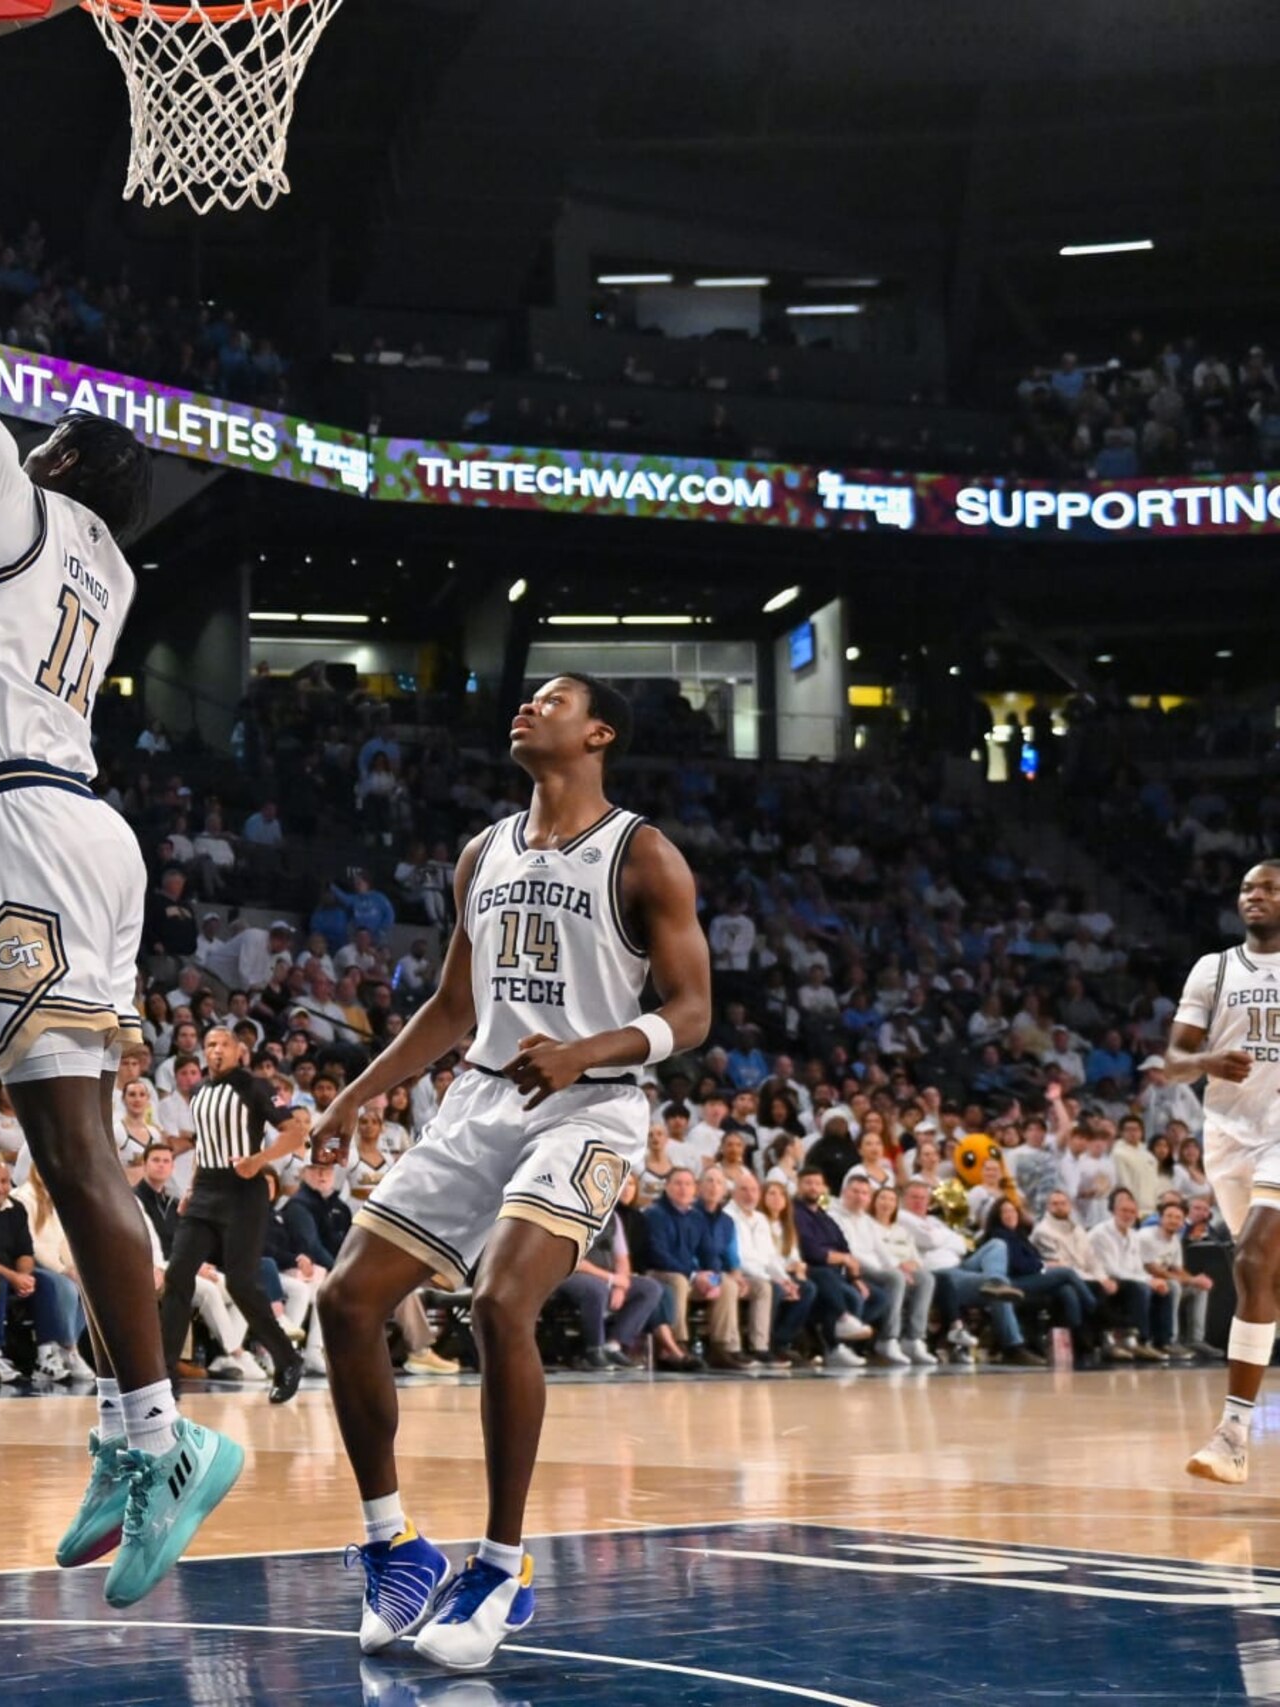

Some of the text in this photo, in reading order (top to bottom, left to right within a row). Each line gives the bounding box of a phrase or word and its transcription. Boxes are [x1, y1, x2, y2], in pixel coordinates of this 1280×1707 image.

[417, 456, 771, 508] THETECHWAY.COM
[35, 583, 101, 719] 11
[477, 879, 593, 920] GEORGIA
[497, 911, 559, 973] 14
[491, 976, 567, 1007] TECH
